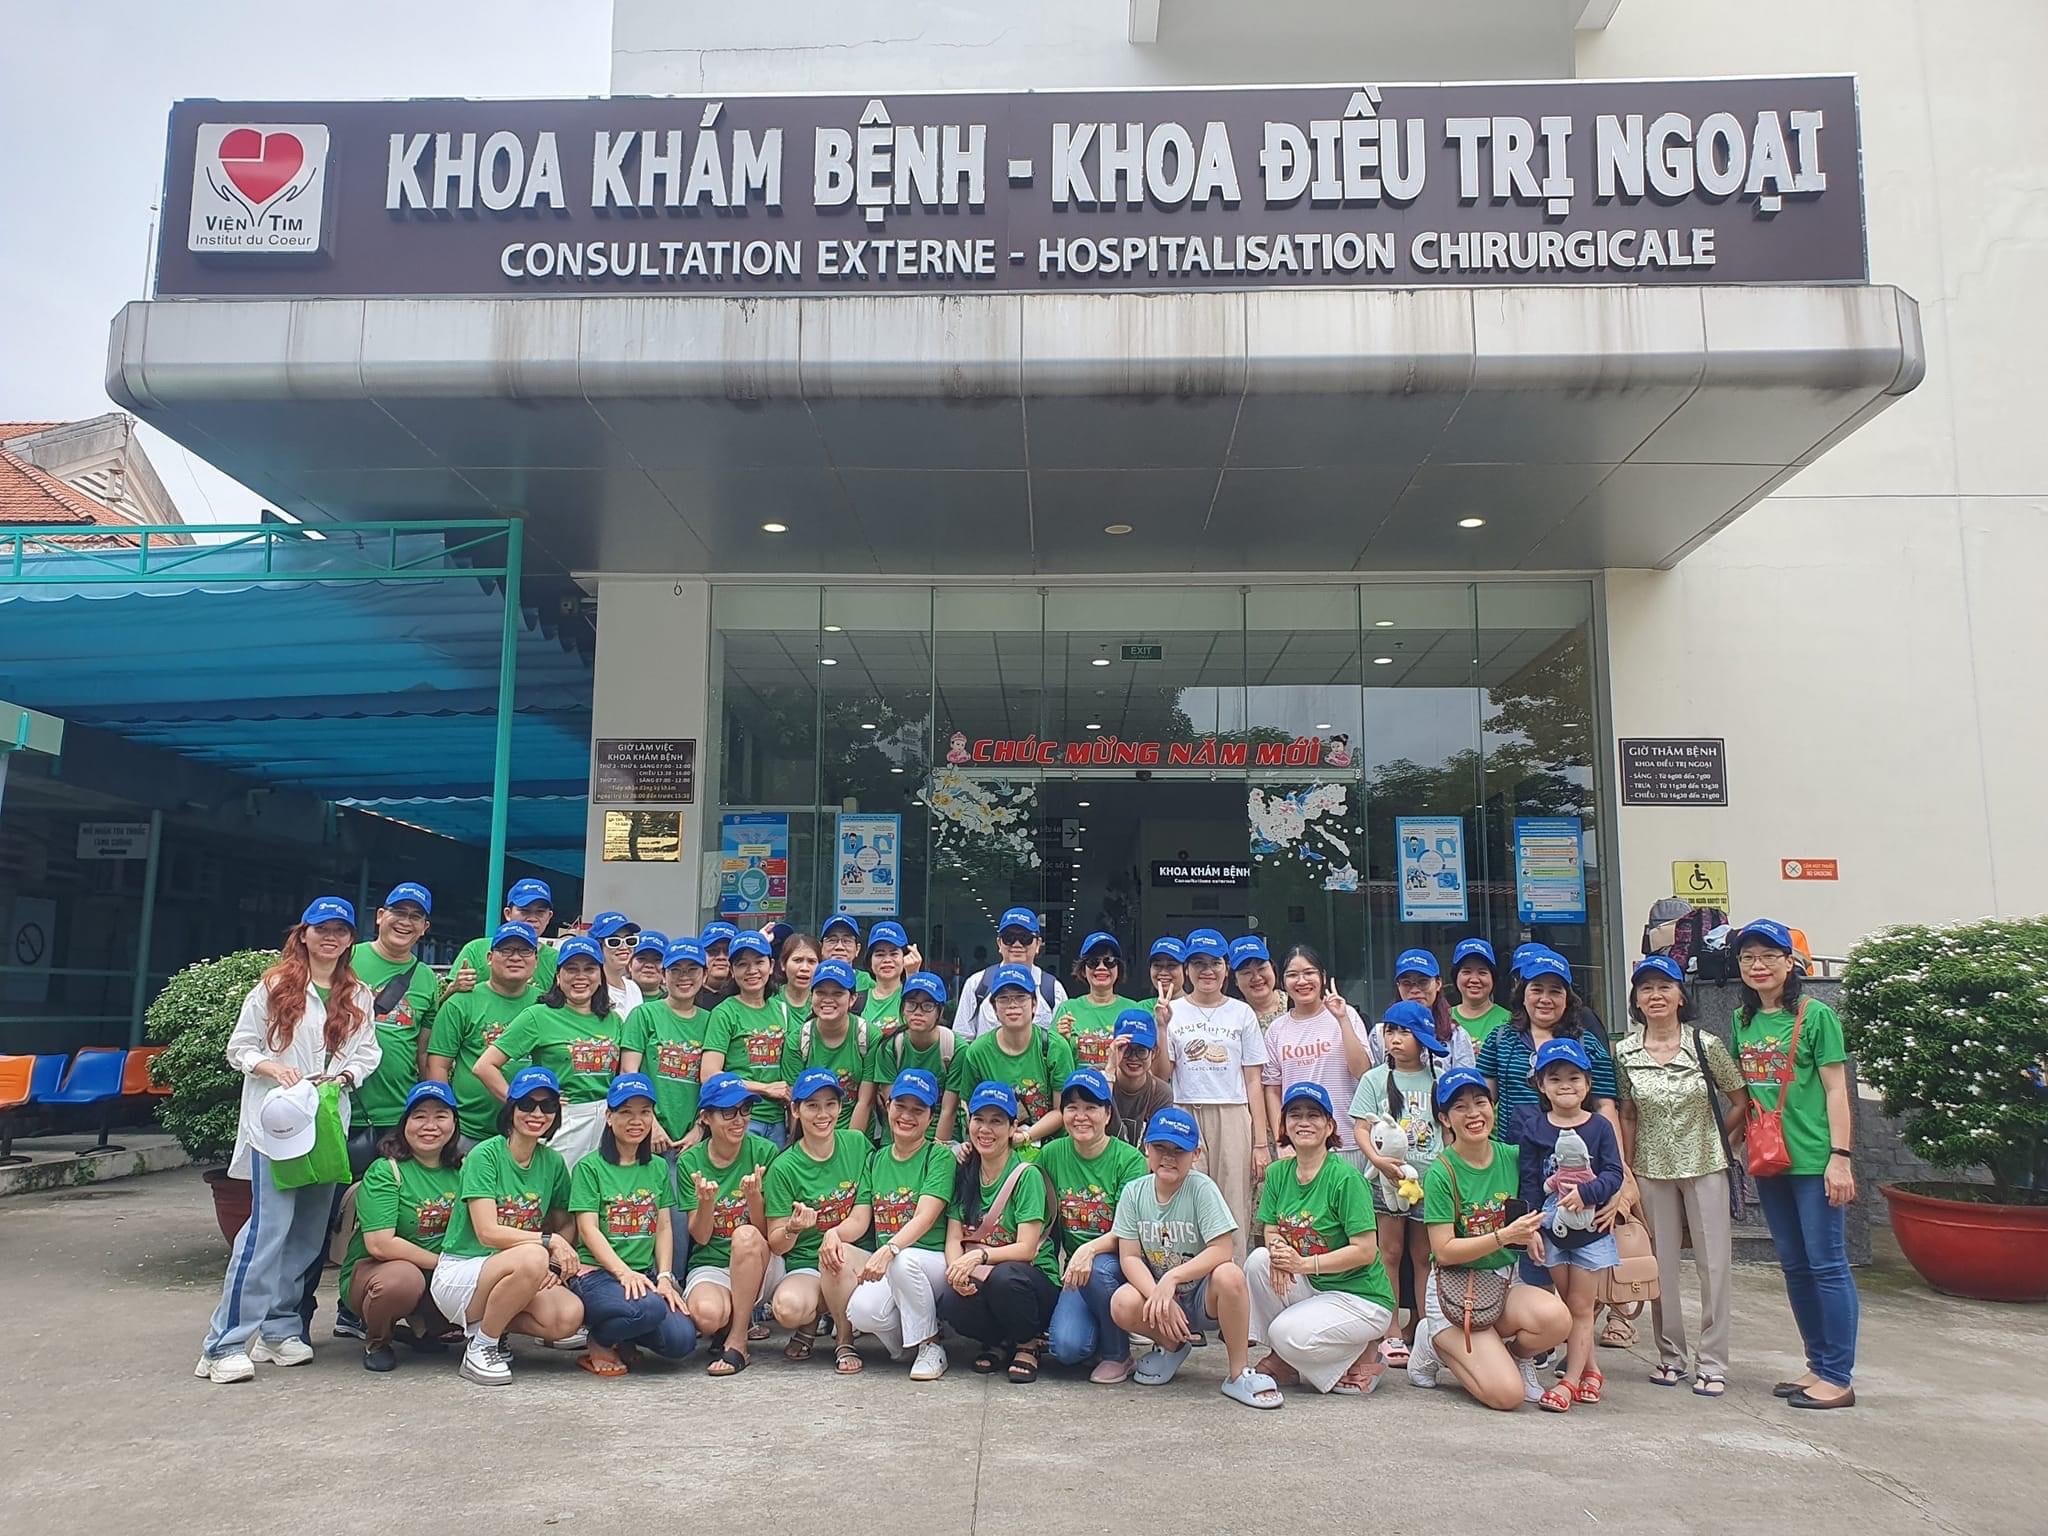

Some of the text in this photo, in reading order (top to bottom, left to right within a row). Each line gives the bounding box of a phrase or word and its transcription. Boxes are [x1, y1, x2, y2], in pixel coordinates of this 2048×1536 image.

[386, 130, 568, 210] KHOA
[590, 101, 783, 207] KHÁM
[813, 99, 985, 223] BỆNH
[1052, 121, 1240, 203] KHOA
[1260, 85, 1427, 201] ĐIỀU
[1445, 114, 1574, 216] TRỊ
[1596, 110, 1826, 212] NGOẠI
[196, 234, 312, 245] Institut du Coeur
[500, 240, 801, 278] CONSULTATION
[816, 239, 996, 276] EXTERNE
[1038, 231, 1396, 274] HOSPITALISATION
[1409, 227, 1717, 269] CHIRURGICALE
[1131, 647, 1152, 655] EXIT
[618, 742, 674, 752] GIỜ LÀM VIỆC
[972, 734, 1321, 765] CHÚC MỪNG NĂM MỚI
[1629, 745, 1717, 758] GIỜ THĂM BỆNH
[633, 752, 659, 761] KHÁM
[660, 753, 683, 762] BỆNH
[1159, 864, 1251, 879] KHOA KHÁM BỆNH
[1281, 1038, 1331, 1061] Rouje
